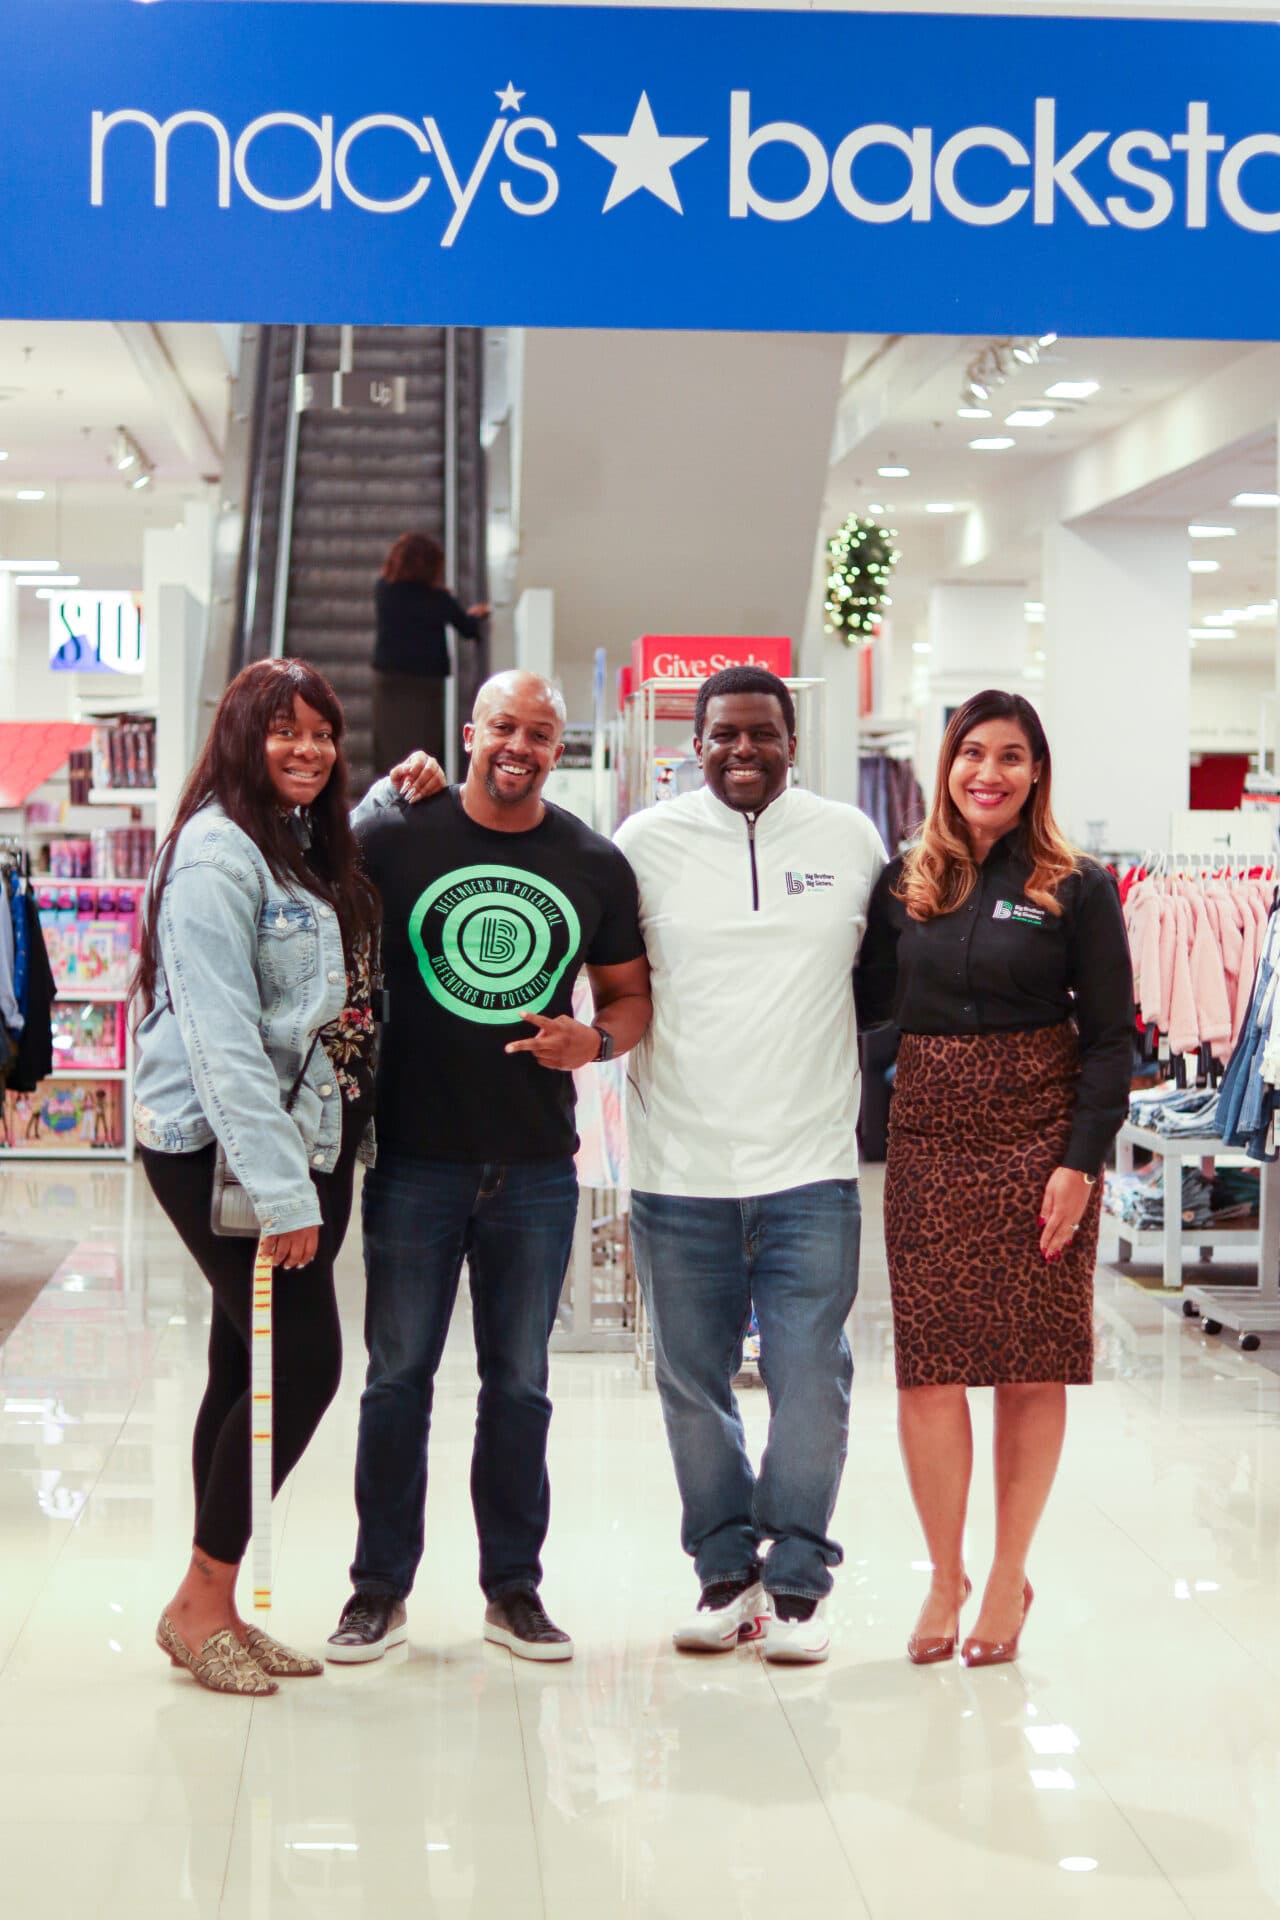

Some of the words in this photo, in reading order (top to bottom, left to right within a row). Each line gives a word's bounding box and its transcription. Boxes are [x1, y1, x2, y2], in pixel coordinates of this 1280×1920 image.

[91, 80, 559, 247] macy's
[652, 653, 708, 677] Give
[434, 880, 493, 914] DEFENDERS
[496, 880, 509, 892] OF
[512, 883, 563, 926] POTENTIAL
[431, 955, 480, 1003] DEFENDERS
[482, 994, 497, 1007] OF
[501, 970, 552, 1007] POTENTIAL
